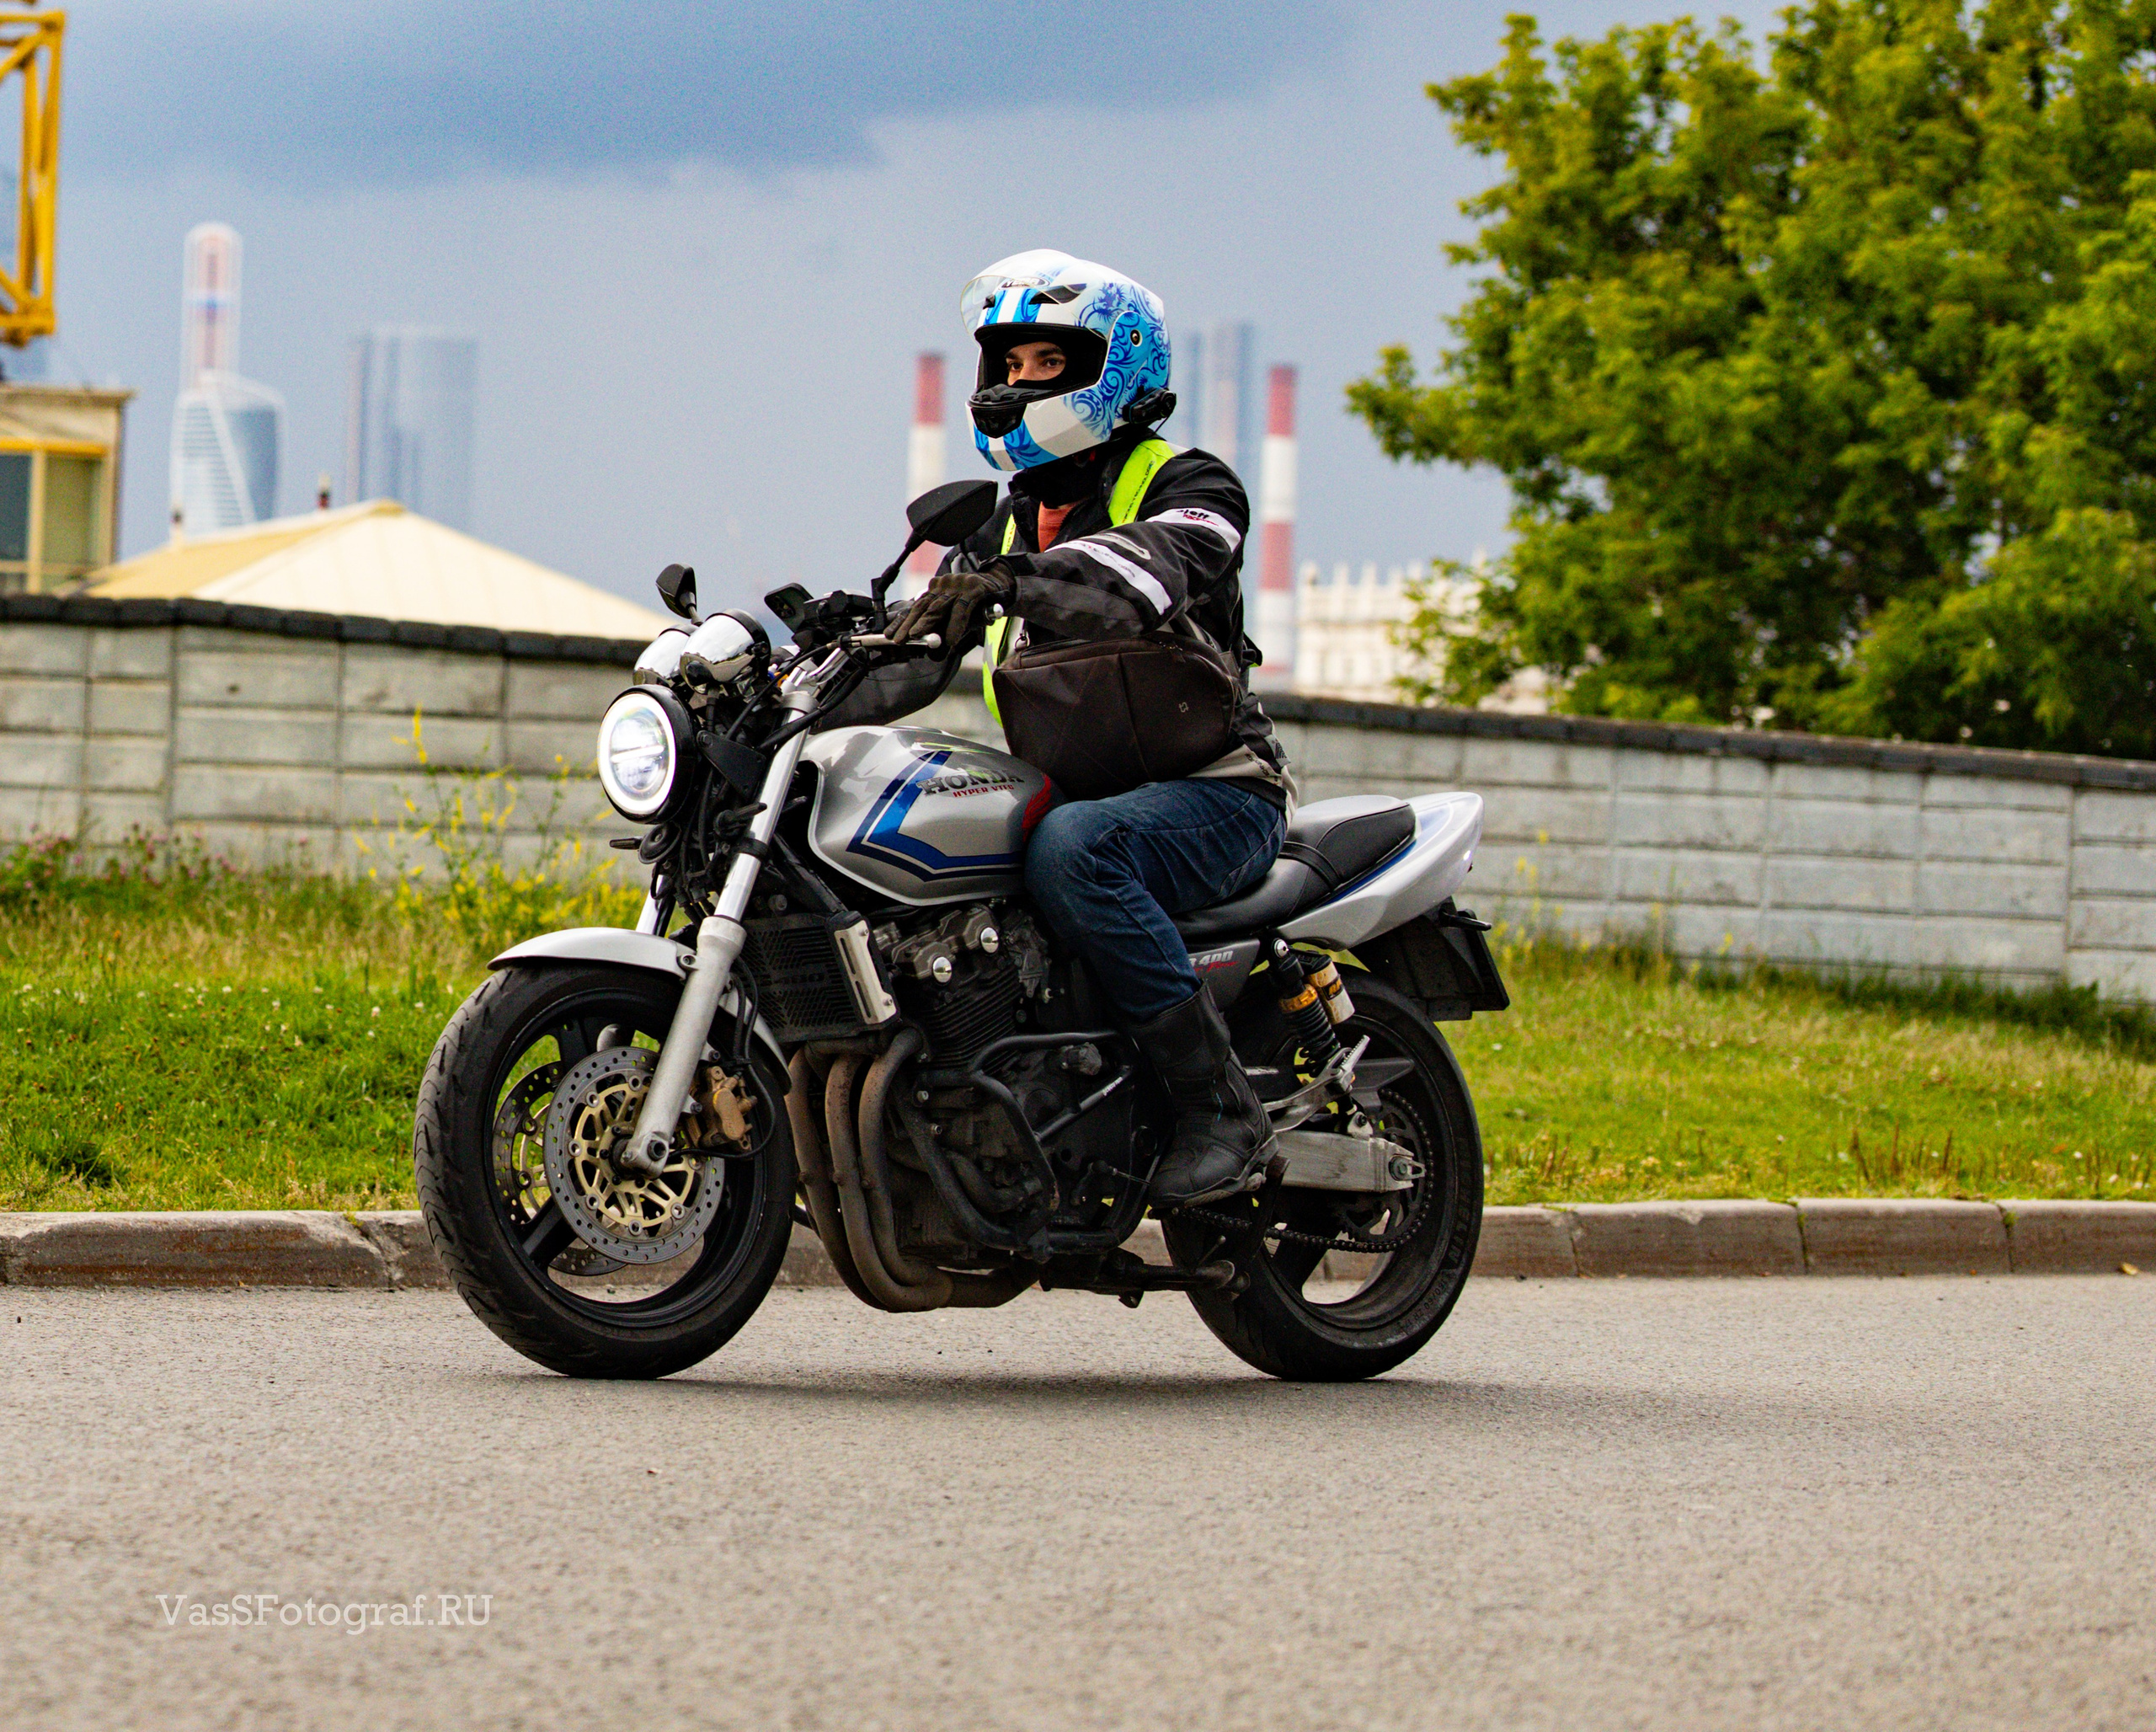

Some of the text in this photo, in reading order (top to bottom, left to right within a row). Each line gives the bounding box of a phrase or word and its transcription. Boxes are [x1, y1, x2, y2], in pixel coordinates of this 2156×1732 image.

[916, 769, 1025, 797] HONDA
[953, 786, 989, 798] HYPER
[1199, 950, 1233, 966] 400
